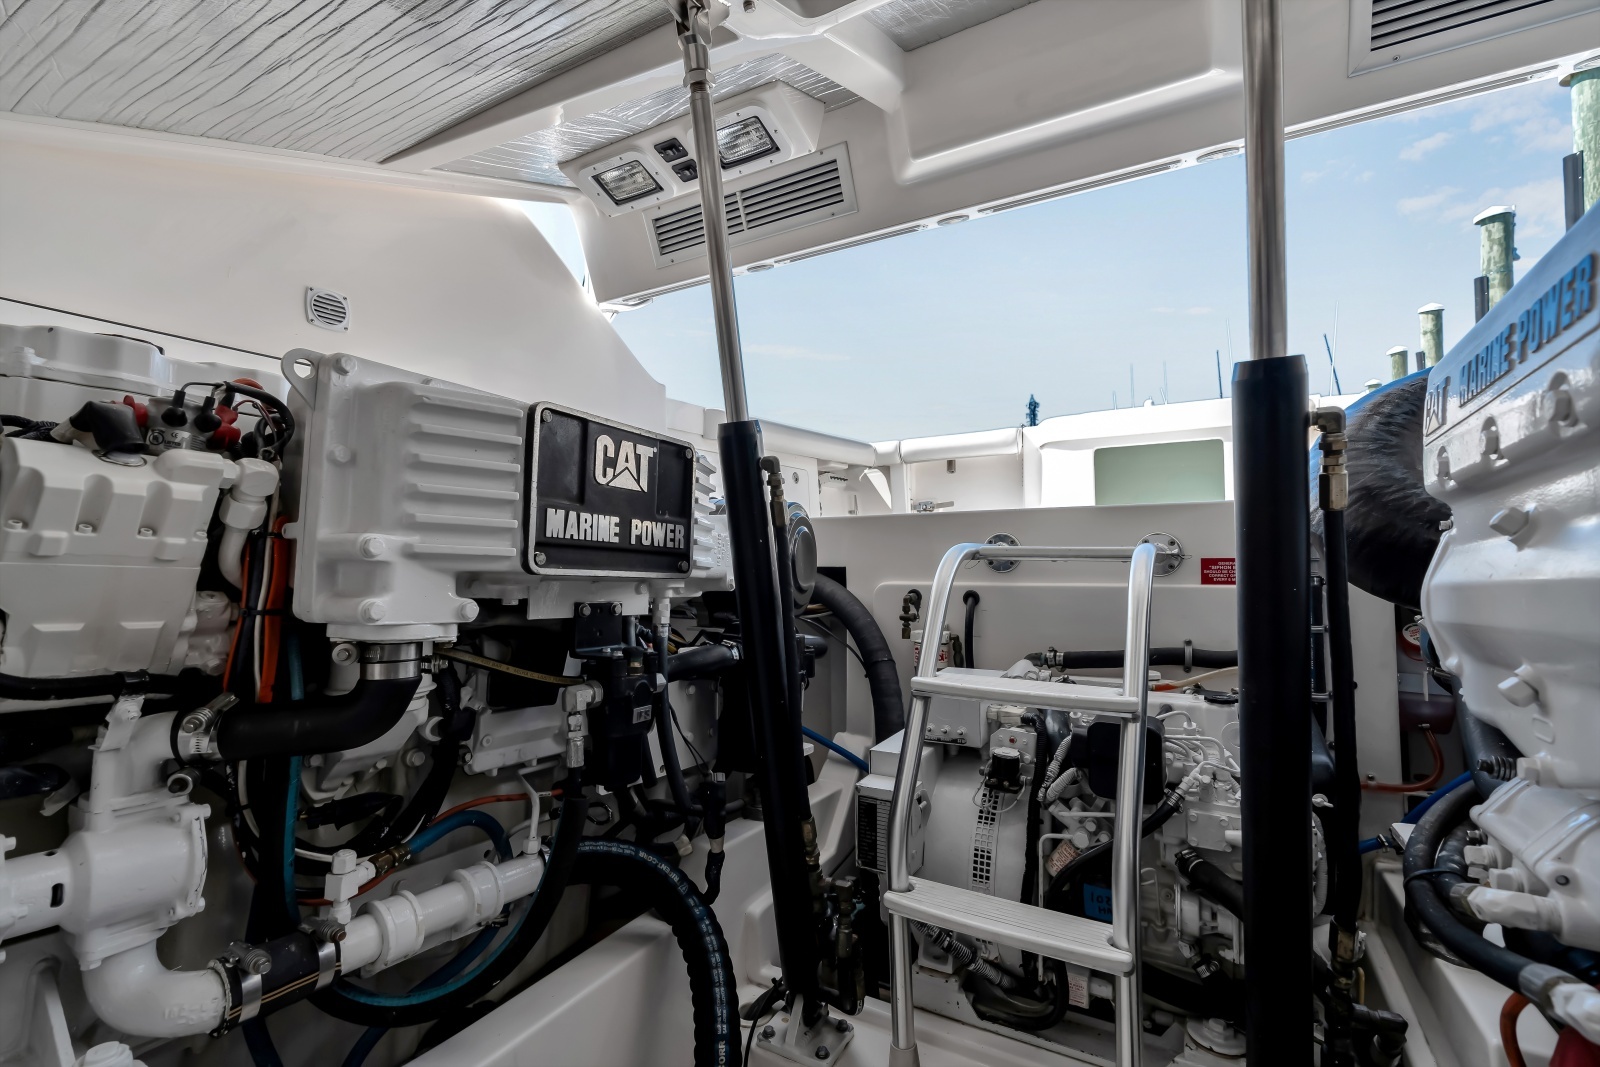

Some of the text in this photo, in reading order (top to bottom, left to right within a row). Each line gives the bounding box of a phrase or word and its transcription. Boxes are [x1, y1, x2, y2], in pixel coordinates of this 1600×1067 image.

[1459, 322, 1516, 408] MARINE
[1517, 253, 1597, 364] POWER
[594, 434, 655, 493] CAT
[545, 507, 685, 549] MARINE POWER
